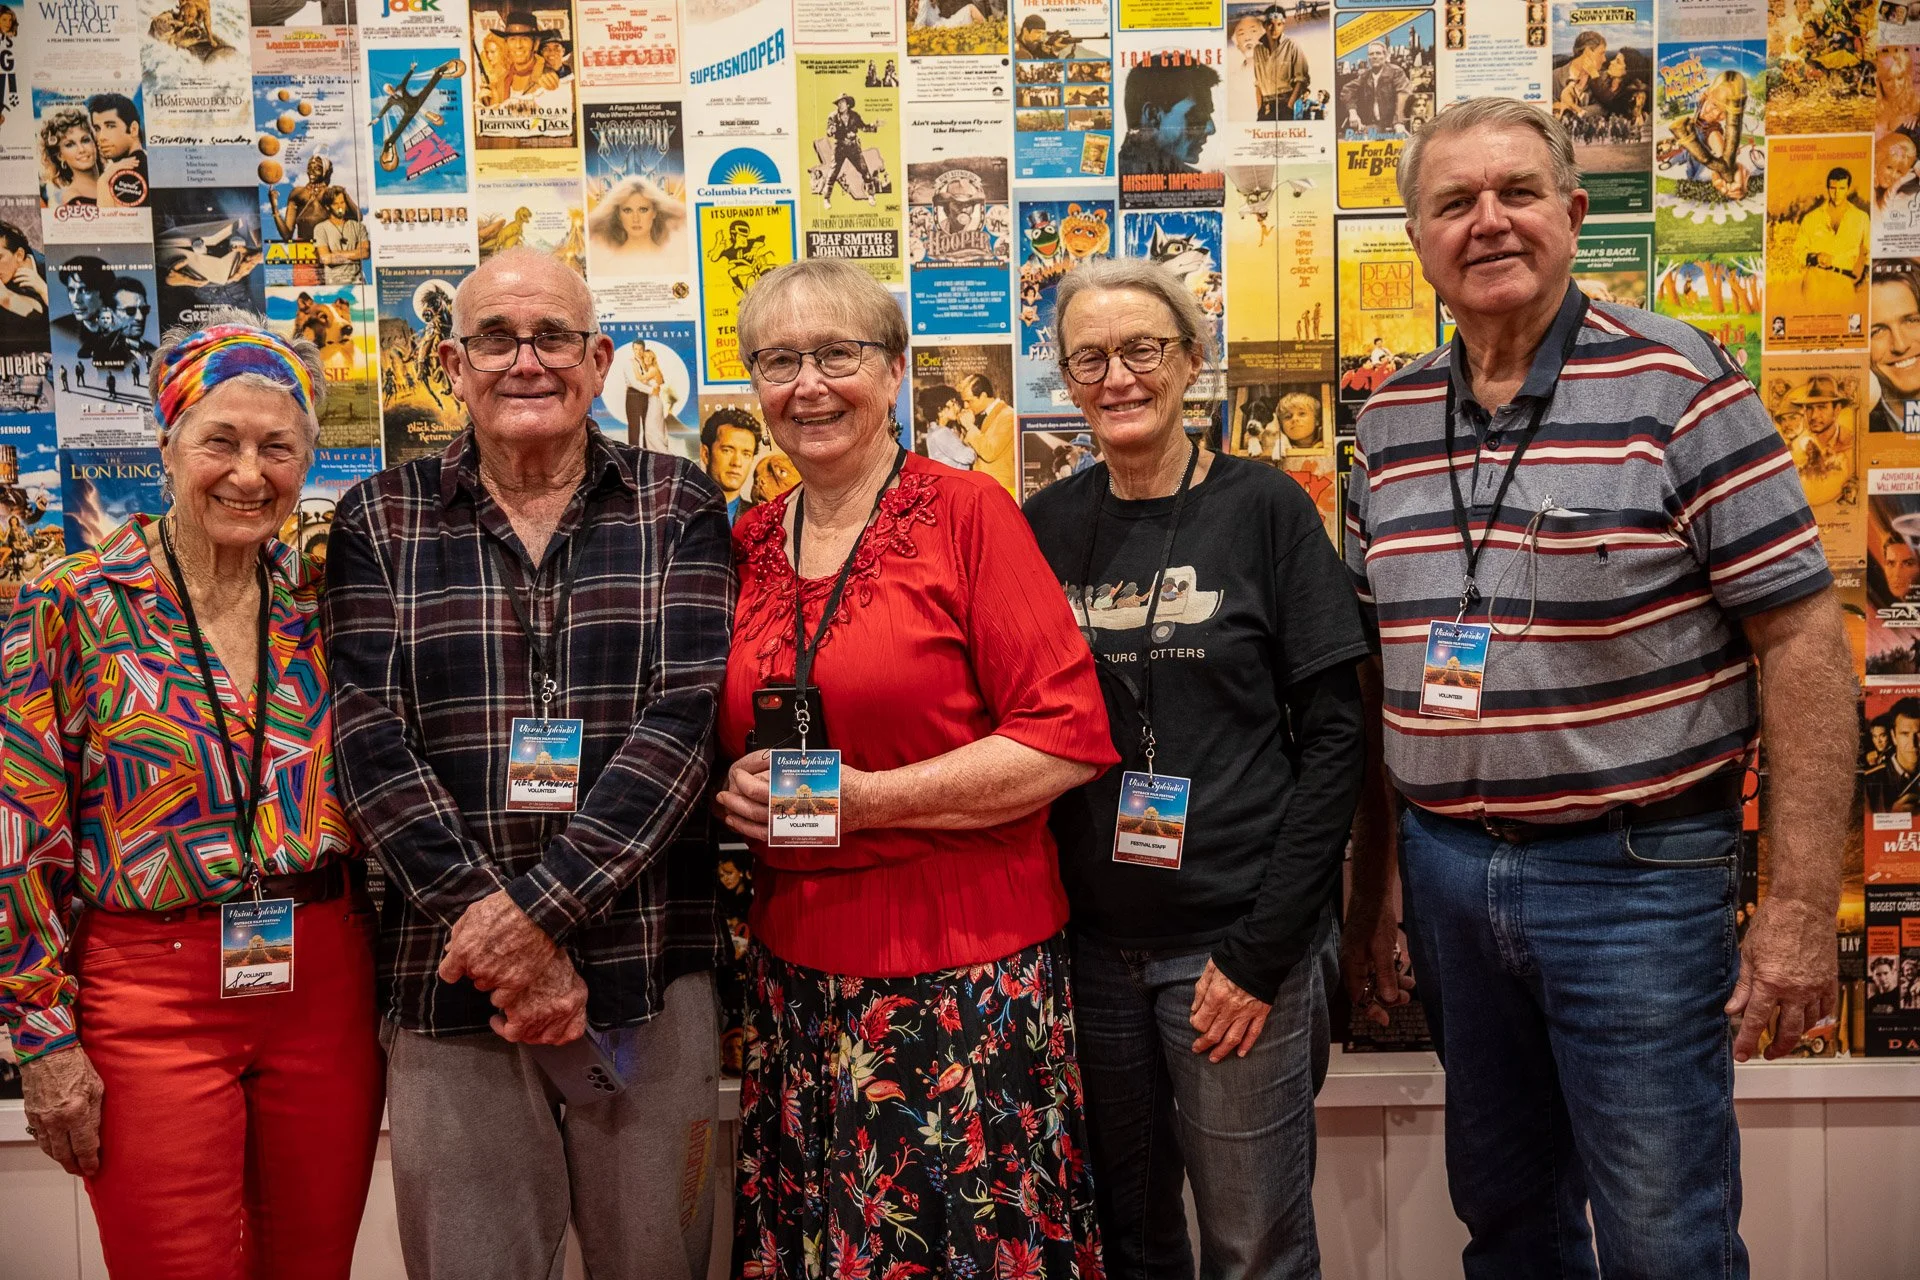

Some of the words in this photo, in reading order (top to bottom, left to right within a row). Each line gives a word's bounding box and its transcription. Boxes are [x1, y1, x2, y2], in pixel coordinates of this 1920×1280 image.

[38, 2, 119, 20] WITHOUT
[1570, 12, 1603, 23] SNOWY
[1605, 10, 1635, 22] RIVER
[66, 18, 111, 36] FACE
[605, 24, 648, 32] TOWERING
[617, 20, 632, 28] THE
[609, 32, 643, 41] INFERNO
[302, 40, 339, 49] WEAPON
[690, 27, 786, 85] SUPERSNOOPER
[1121, 51, 1151, 68] TOM
[1161, 48, 1223, 67] CRUISE
[155, 94, 209, 107] HOMEWARD
[210, 96, 243, 106] BOUND
[480, 107, 513, 116] PAUL
[530, 107, 568, 116] HOGAN
[479, 118, 530, 132] LIGHTNING
[538, 118, 569, 132] JACK
[1252, 129, 1288, 140] Karate
[1289, 128, 1307, 138] Kid
[1361, 144, 1383, 157] FORT
[1816, 151, 1868, 162] DANGEROUSLY
[1347, 151, 1369, 170] THE
[1122, 174, 1167, 193] MISSION:
[1168, 172, 1225, 192] IMPOSSIBLE
[697, 187, 747, 197] Columbia
[749, 187, 792, 196] Pictures
[54, 201, 99, 221] GREASE
[726, 209, 737, 218] UP
[737, 208, 754, 218] AND
[812, 219, 837, 228] ANTHONY
[838, 218, 855, 228] QUINN
[843, 233, 882, 245] SMITH
[884, 232, 893, 245] &
[928, 231, 993, 257] HOOPER
[266, 243, 317, 259] AIR
[813, 245, 860, 257] JOHNNY
[1606, 247, 1636, 256] BACK!
[1362, 264, 1412, 280] DEAD
[1875, 264, 1912, 273] HUGH
[1362, 281, 1412, 297] POETS
[1363, 297, 1410, 308] SOCIETY
[621, 323, 655, 331] HANKS
[637, 331, 660, 339] MEG
[704, 404, 736, 412] TOM
[1, 425, 31, 435] SERIOUS
[407, 423, 430, 433] Black
[431, 422, 462, 432] Stallion
[319, 451, 377, 463] Murray
[71, 464, 111, 480] LION
[117, 463, 160, 479] KING
[1102, 653, 1137, 664] BURG
[1146, 648, 1206, 660] OTTERS
[1130, 840, 1151, 848] FESTIVAL
[1870, 902, 1896, 912] BIGGEST
[1841, 937, 1861, 952] DAY
[243, 971, 273, 979] VOLUNTEER
